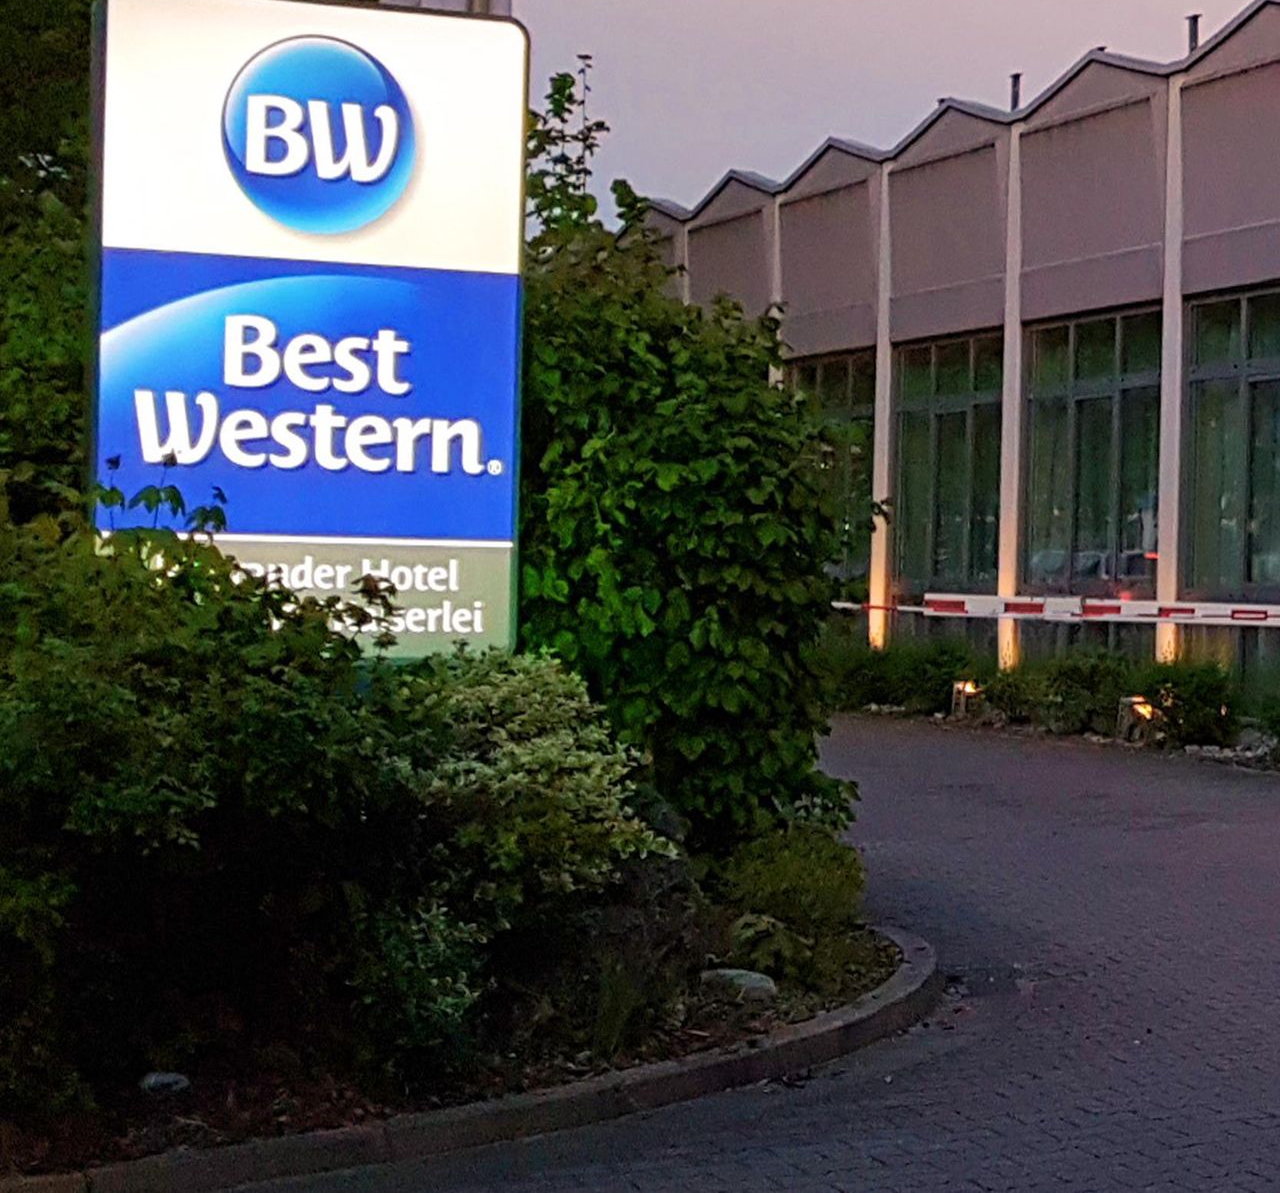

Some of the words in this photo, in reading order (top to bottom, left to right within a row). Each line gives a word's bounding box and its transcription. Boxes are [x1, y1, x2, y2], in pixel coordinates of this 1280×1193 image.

[245, 94, 398, 183] BW
[223, 314, 411, 396] Best
[361, 559, 459, 592] Hotel
